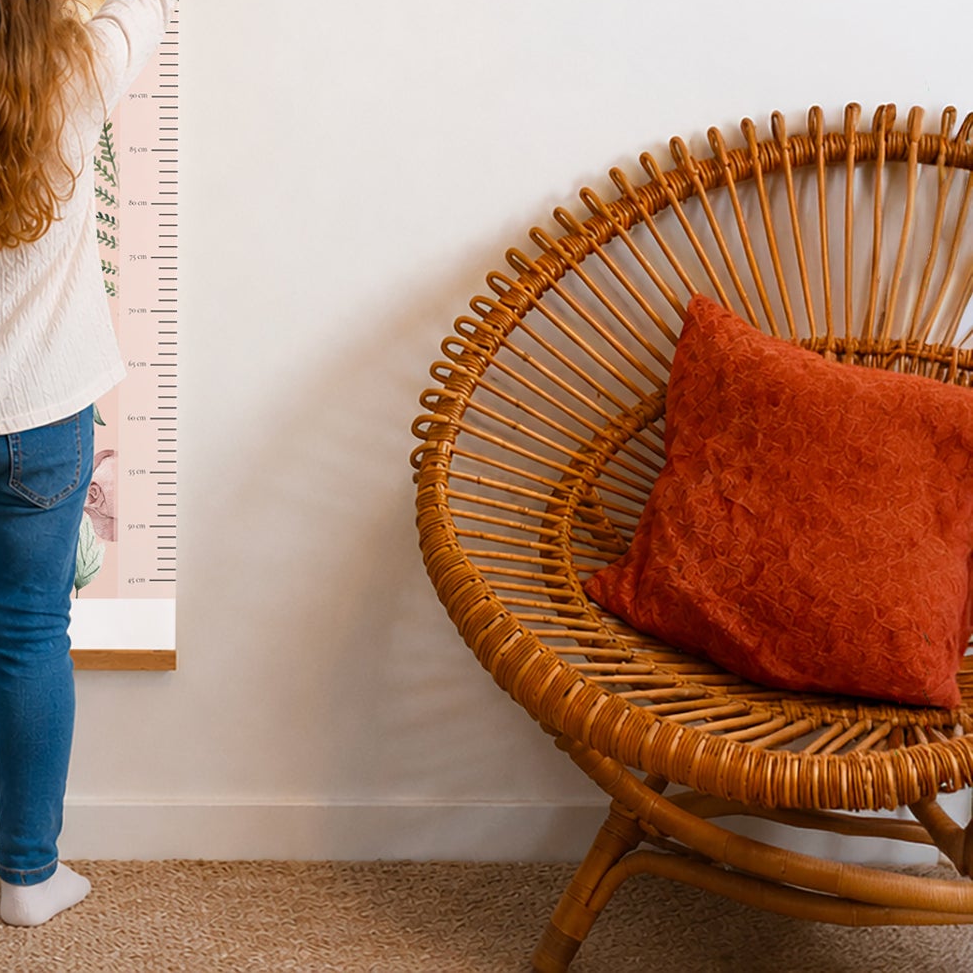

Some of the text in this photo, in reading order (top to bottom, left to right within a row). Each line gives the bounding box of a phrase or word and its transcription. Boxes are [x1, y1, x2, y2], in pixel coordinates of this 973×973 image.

[128, 146, 138, 155] 85
[128, 199, 136, 207] 80
[128, 254, 136, 262] 75
[128, 307, 136, 316] 70
[128, 359, 136, 369] 65
[126, 414, 136, 422] 60
[128, 468, 136, 477] 55
[128, 523, 136, 531] 50
